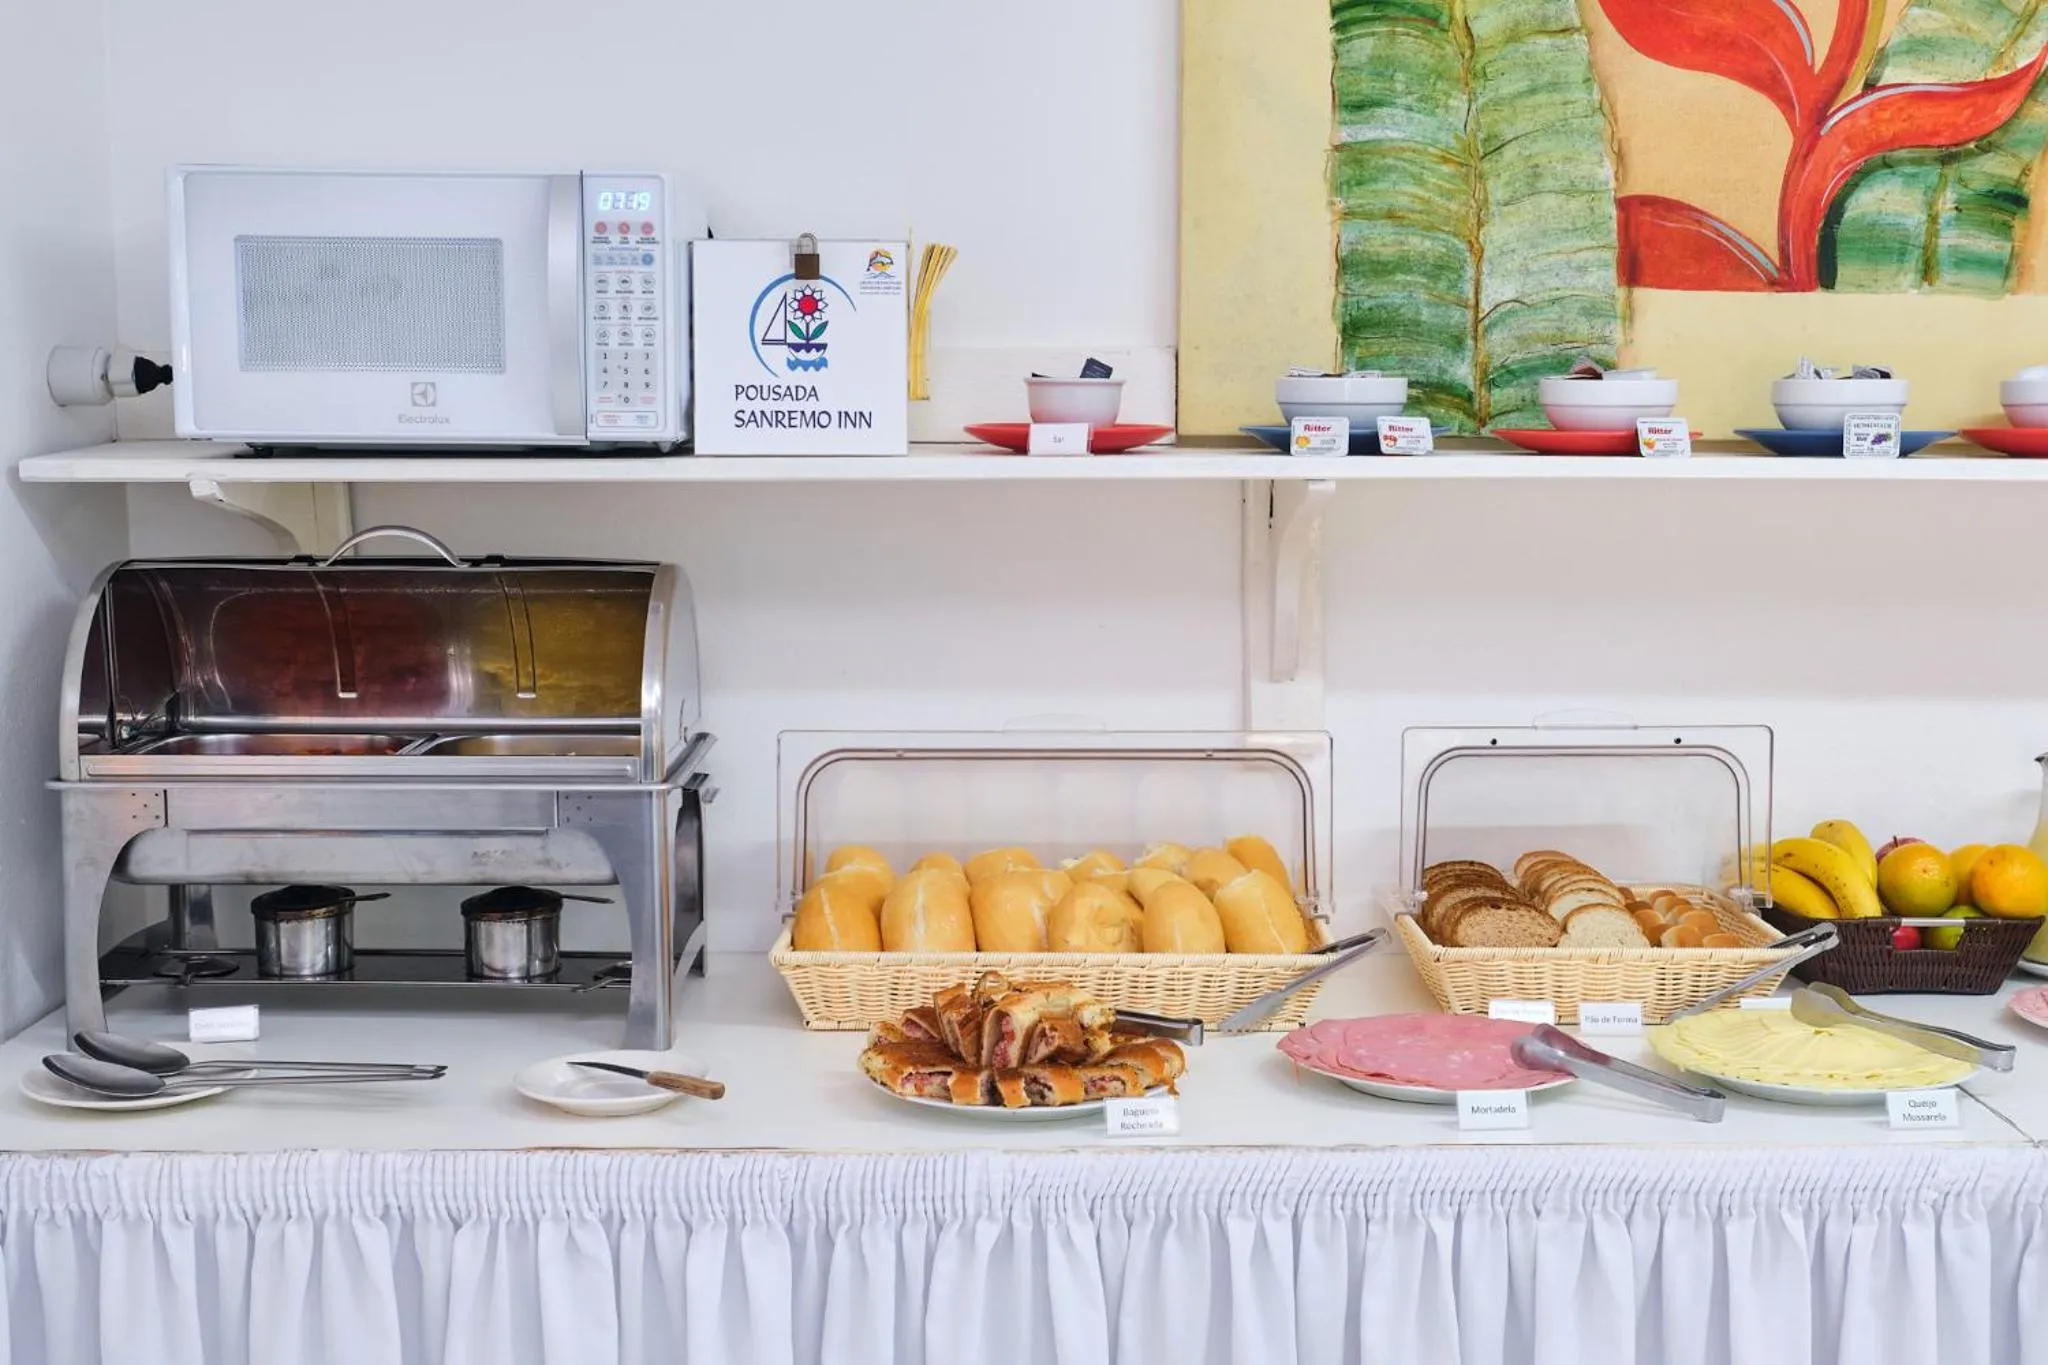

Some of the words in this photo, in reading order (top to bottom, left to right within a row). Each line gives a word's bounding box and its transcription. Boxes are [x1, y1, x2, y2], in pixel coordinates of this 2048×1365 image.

[734, 384, 820, 402] POUSADA
[398, 413, 451, 425] Electrolux
[734, 409, 832, 429] SANREMO
[838, 411, 872, 429] INN
[1303, 424, 1332, 432] Ritter
[1388, 425, 1413, 433] Ritter
[1648, 427, 1672, 435] Ritter
[1601, 1015, 1611, 1024] de
[1613, 1015, 1638, 1024] Forma
[1908, 1099, 1937, 1109] Queijo
[1471, 1105, 1517, 1115] Mortadela
